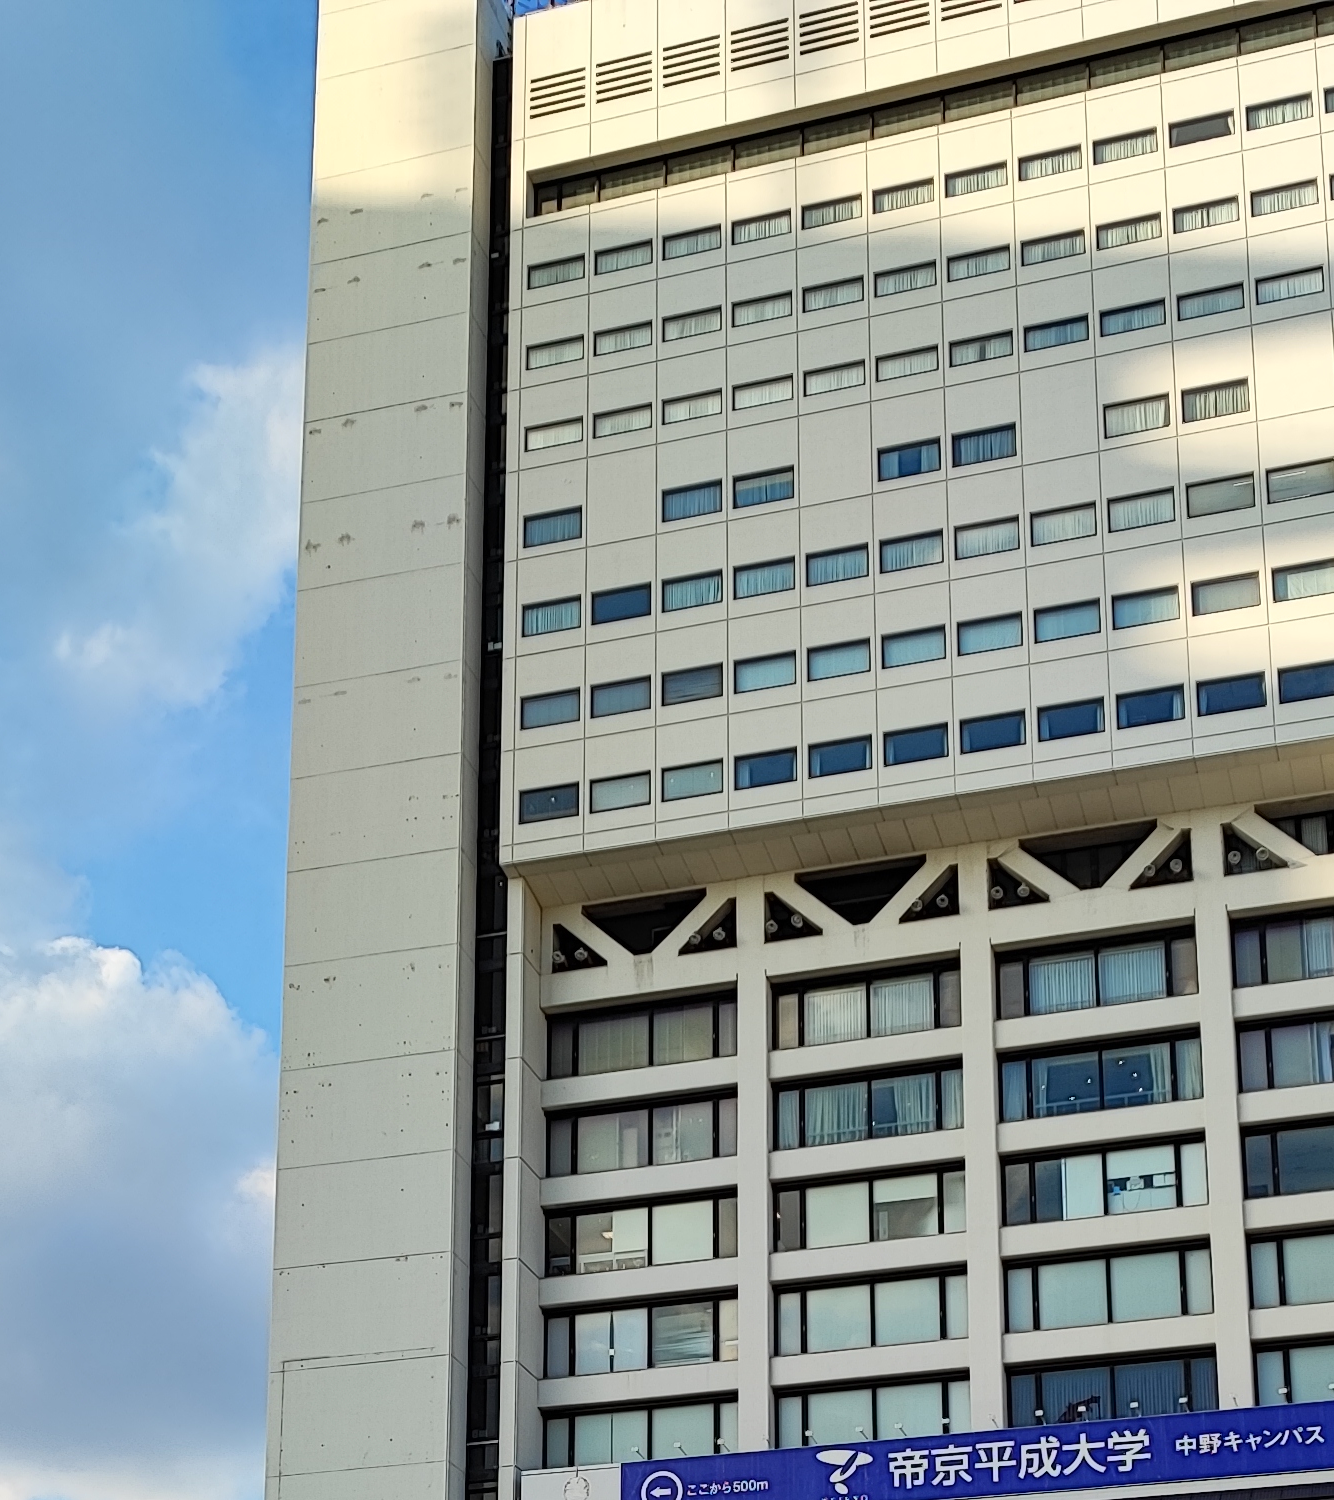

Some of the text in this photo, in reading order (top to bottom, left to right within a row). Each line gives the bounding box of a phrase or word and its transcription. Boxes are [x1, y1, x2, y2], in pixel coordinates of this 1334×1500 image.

[888, 1424, 1326, 1489] 帝京平成大学 中野キャンパス
[687, 1480, 769, 1496] ここから500m
